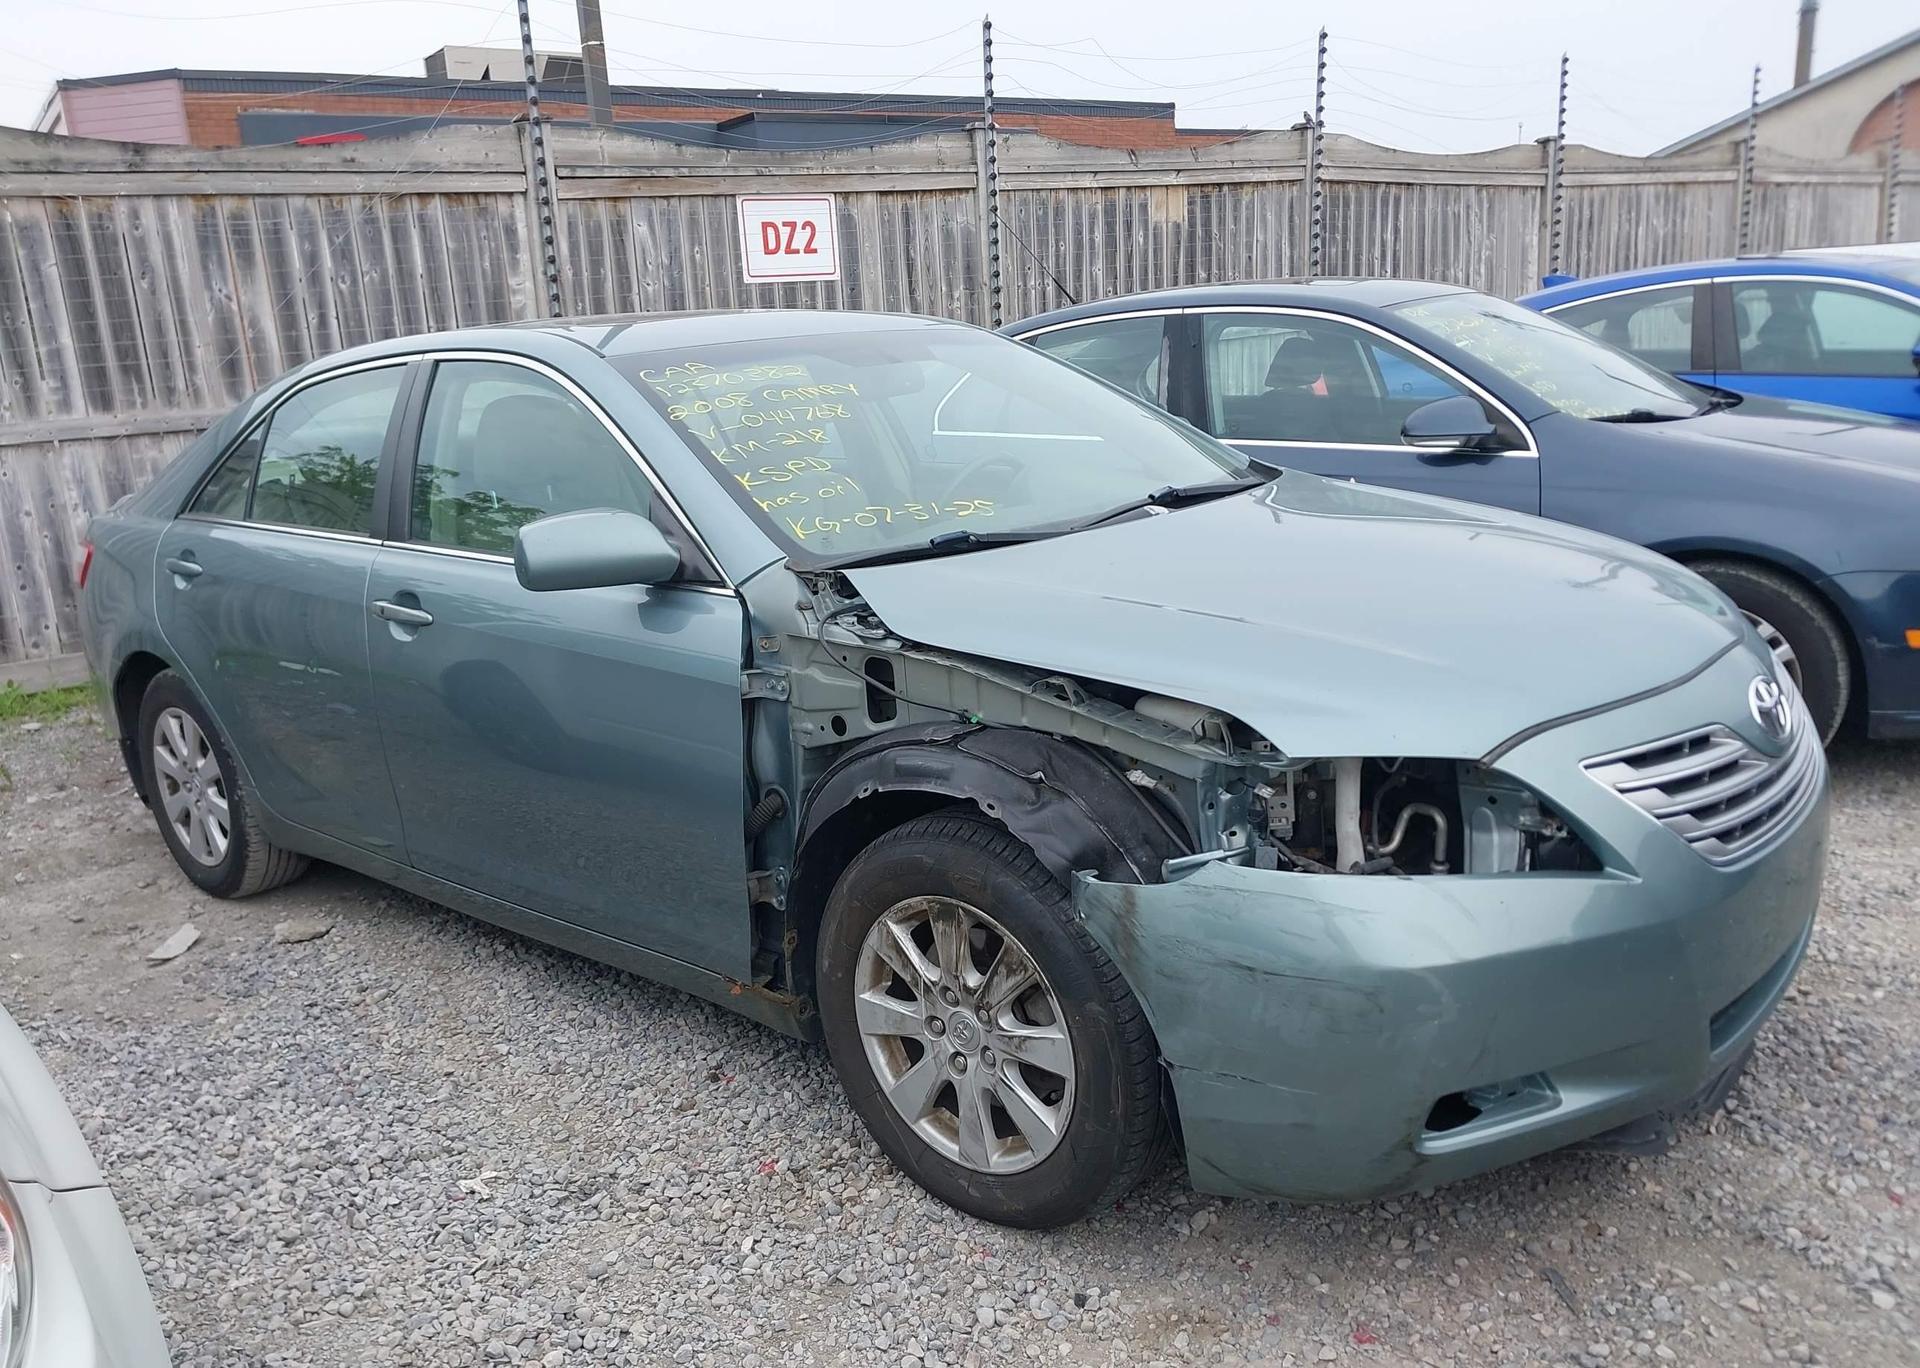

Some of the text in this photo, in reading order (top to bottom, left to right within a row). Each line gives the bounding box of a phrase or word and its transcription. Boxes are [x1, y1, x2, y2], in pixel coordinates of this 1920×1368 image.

[761, 220, 818, 255] DZ2
[640, 362, 715, 383] CAA
[667, 383, 860, 421] 2008 CAMRY
[753, 476, 861, 512] has oil
